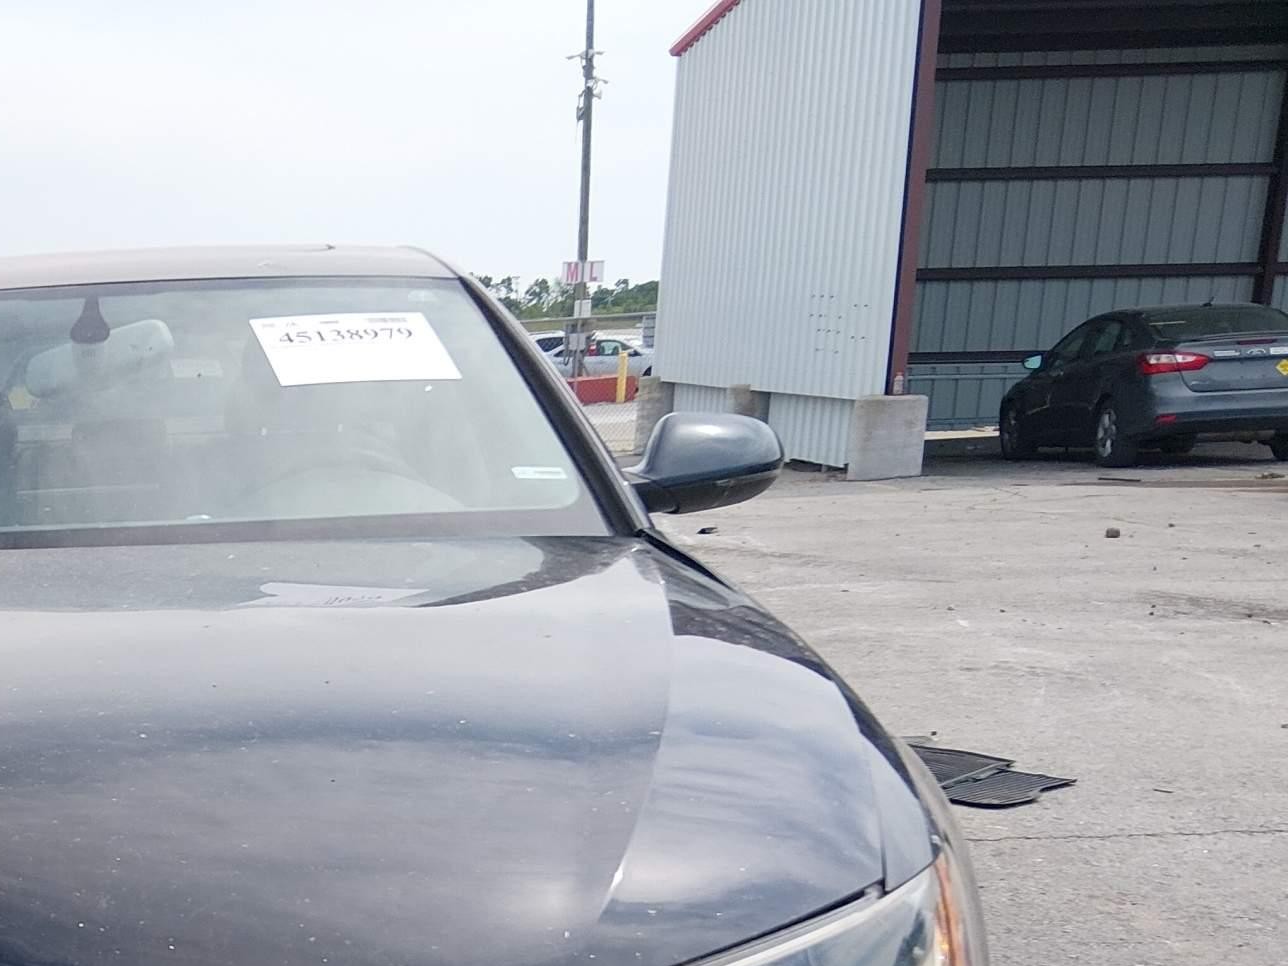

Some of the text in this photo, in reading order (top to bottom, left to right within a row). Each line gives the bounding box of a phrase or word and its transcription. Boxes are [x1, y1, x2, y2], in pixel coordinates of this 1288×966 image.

[566, 262, 598, 282] M L
[279, 327, 413, 343] 45138979
